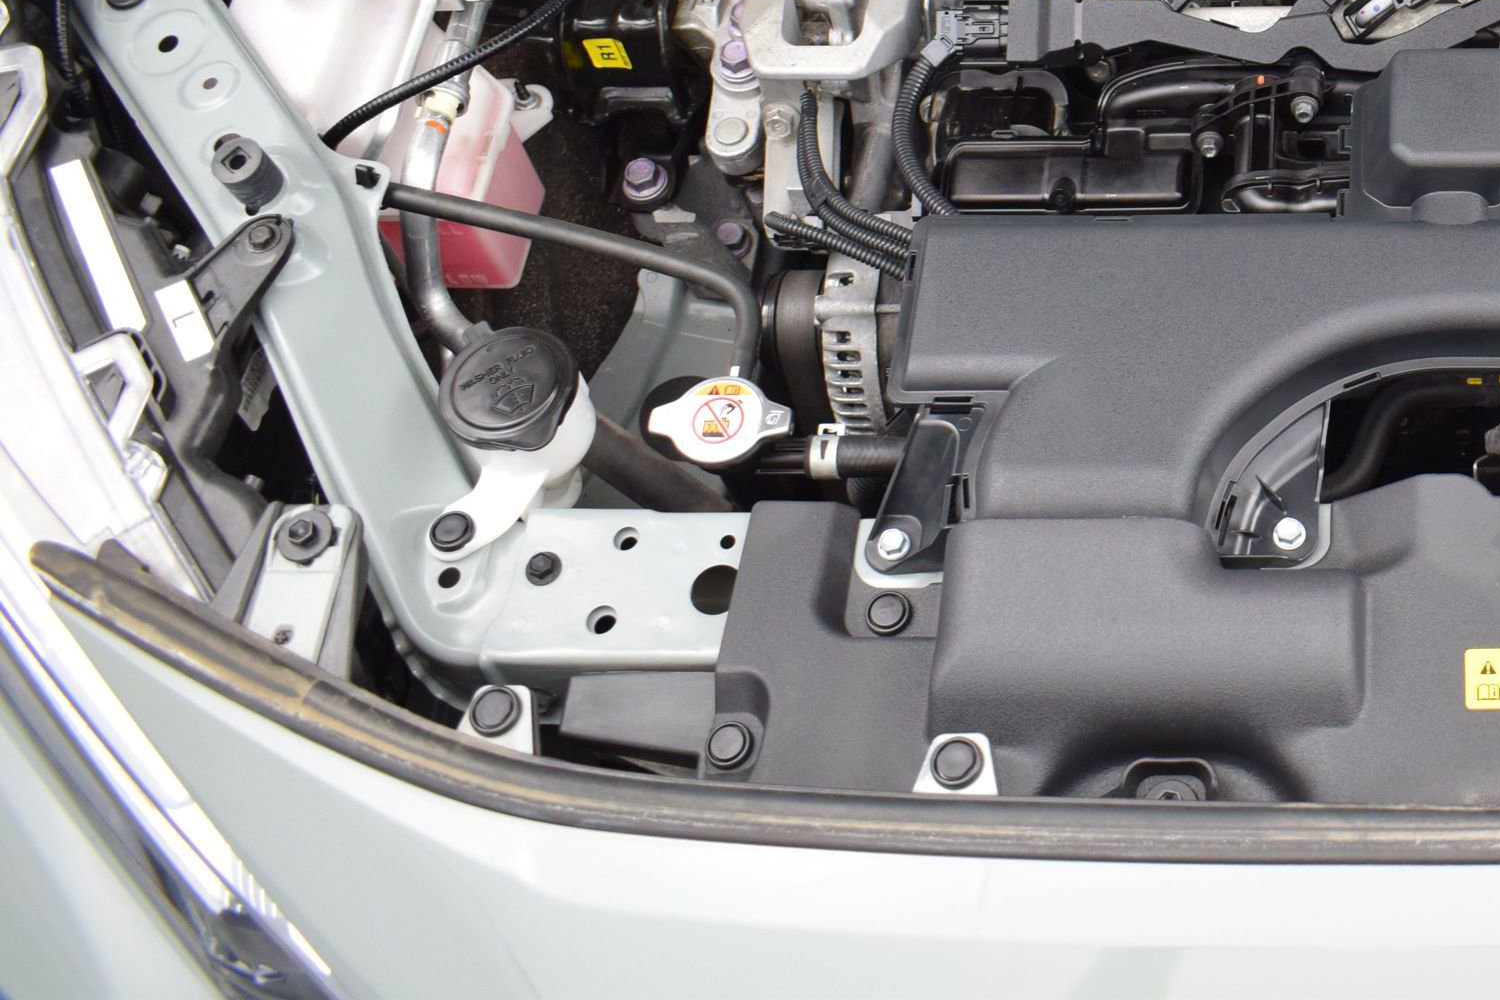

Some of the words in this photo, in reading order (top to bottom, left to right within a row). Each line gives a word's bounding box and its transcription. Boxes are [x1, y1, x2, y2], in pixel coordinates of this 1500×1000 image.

[599, 44, 618, 62] R1
[458, 362, 503, 392] WASHER
[505, 343, 537, 366] FLUID
[487, 366, 516, 385] ONLY
